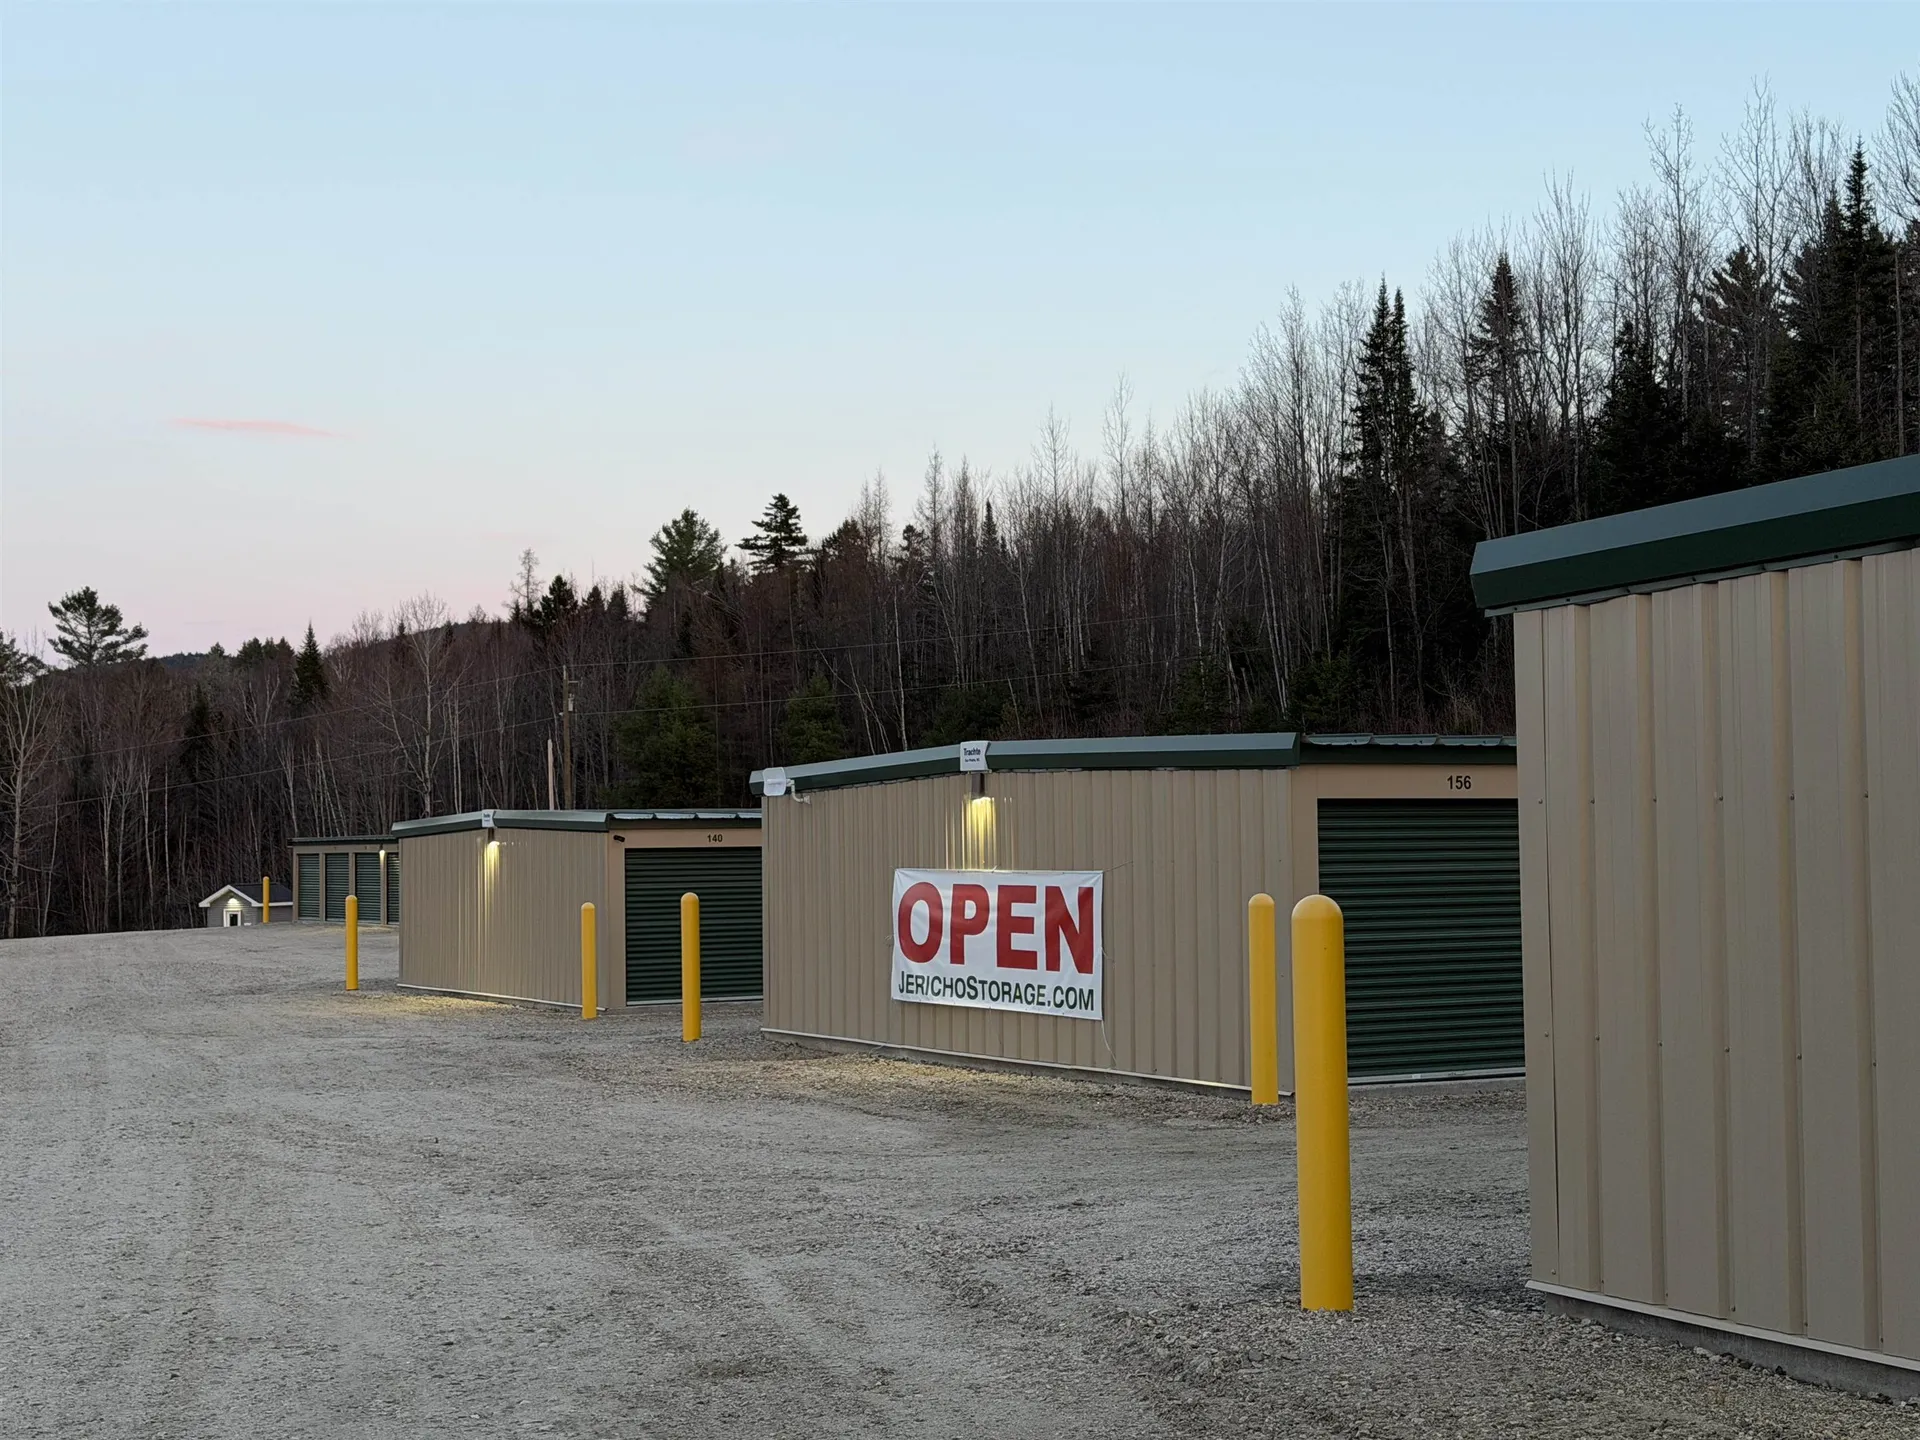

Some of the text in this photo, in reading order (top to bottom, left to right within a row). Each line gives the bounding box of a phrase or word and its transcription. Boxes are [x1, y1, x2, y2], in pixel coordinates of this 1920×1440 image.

[1447, 775, 1472, 790] 156
[707, 834, 723, 843] 140
[898, 881, 1094, 975] OPEN
